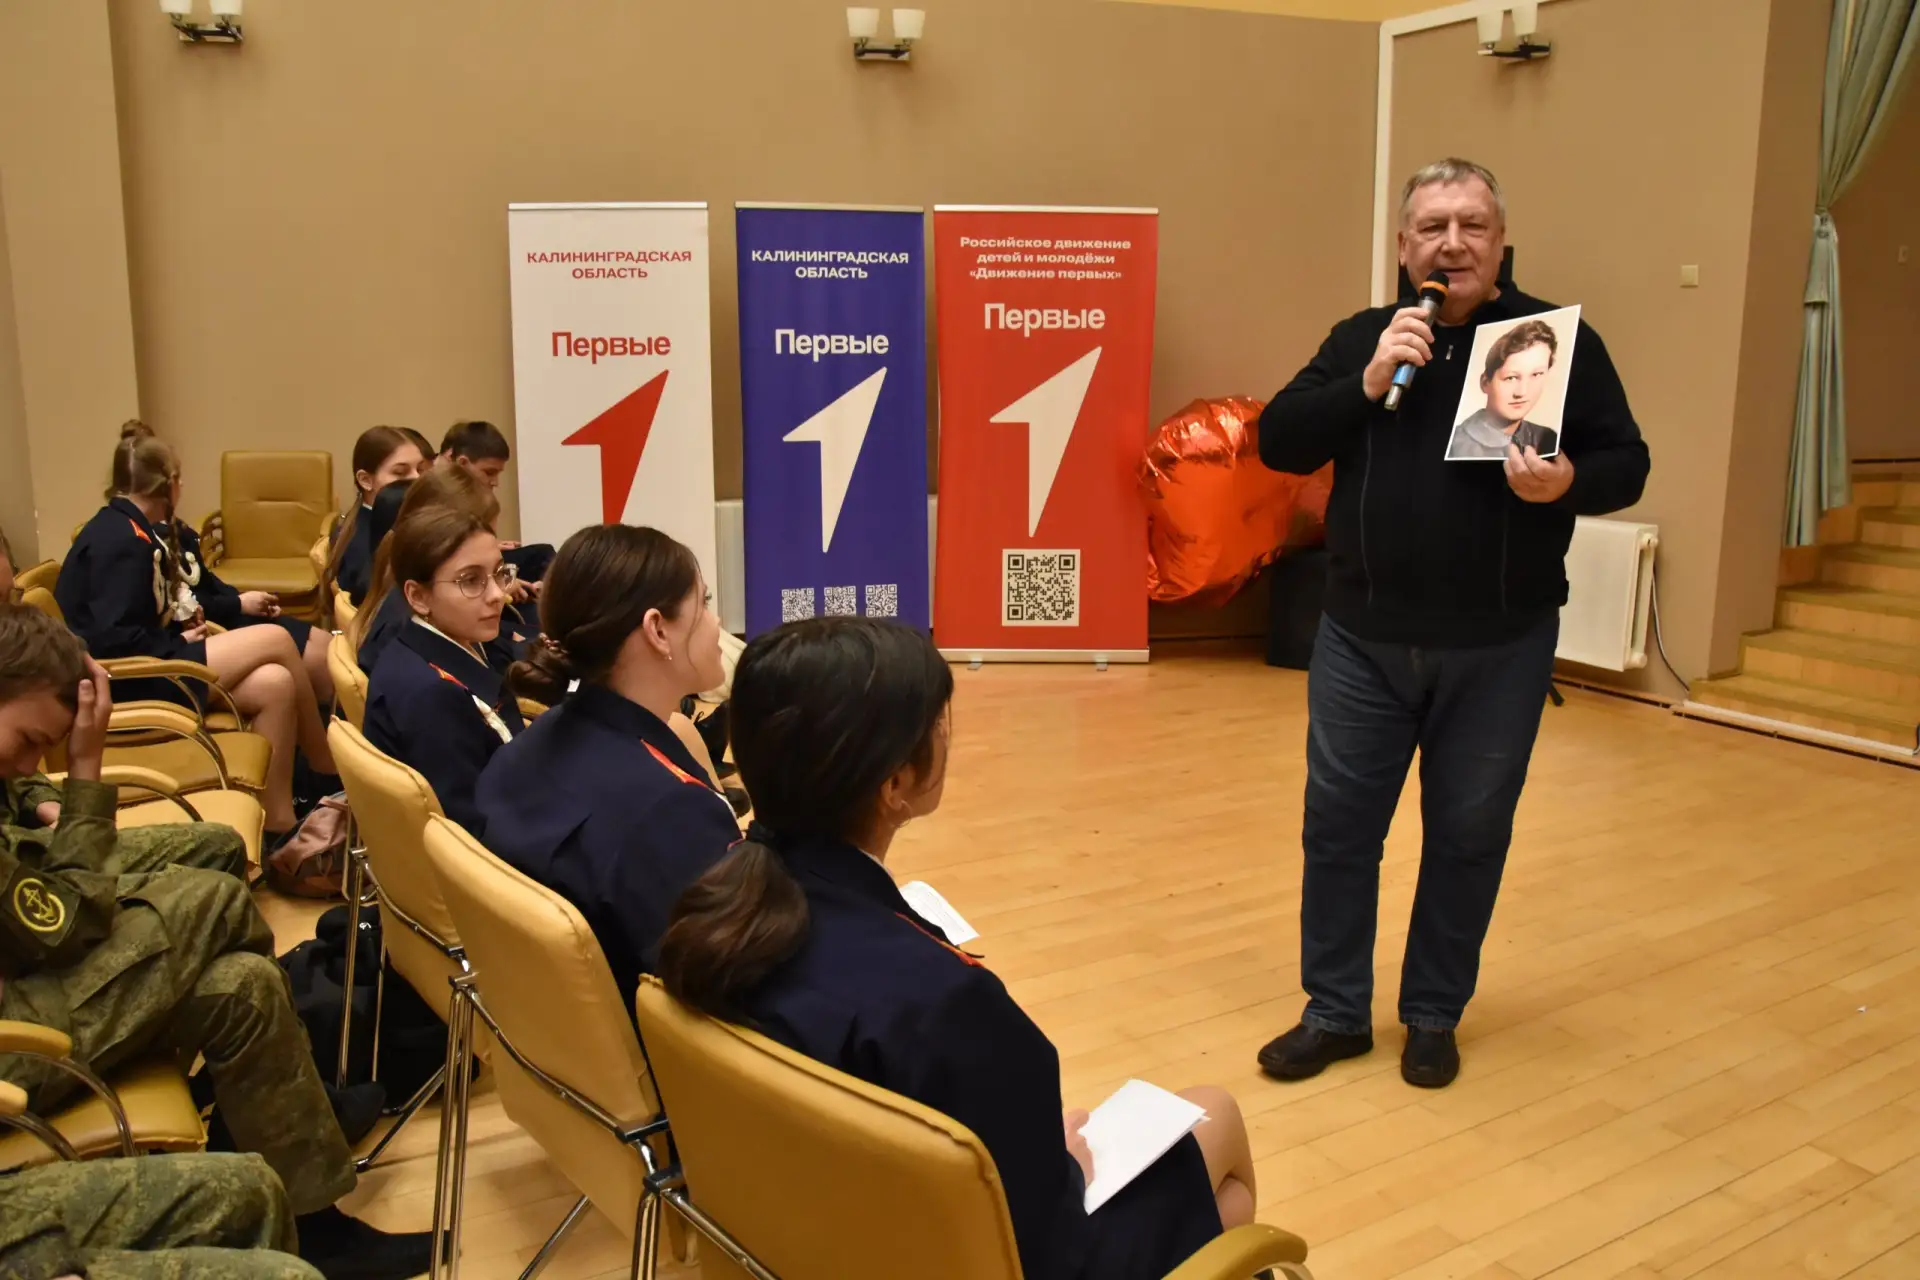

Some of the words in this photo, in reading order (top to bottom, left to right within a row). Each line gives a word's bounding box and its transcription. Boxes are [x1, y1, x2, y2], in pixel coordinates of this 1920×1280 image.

[960, 236, 1052, 248] Российское
[1054, 238, 1131, 250] движение
[527, 251, 692, 264] КАЛИНИНГРАДСКАЯ
[751, 250, 909, 265] КАЛИНИНГРАДСКАЯ
[976, 252, 1022, 264] детей
[1023, 254, 1034, 263] и
[1036, 252, 1115, 265] молодёжи
[572, 267, 648, 279] ОБЛАСТЬ
[795, 266, 868, 279] ОБЛАСТЬ
[969, 267, 1055, 280] «Движение
[1058, 269, 1122, 281] первых»
[984, 303, 1106, 338] Первые
[552, 332, 671, 365] Первые
[775, 328, 889, 362] Первые
